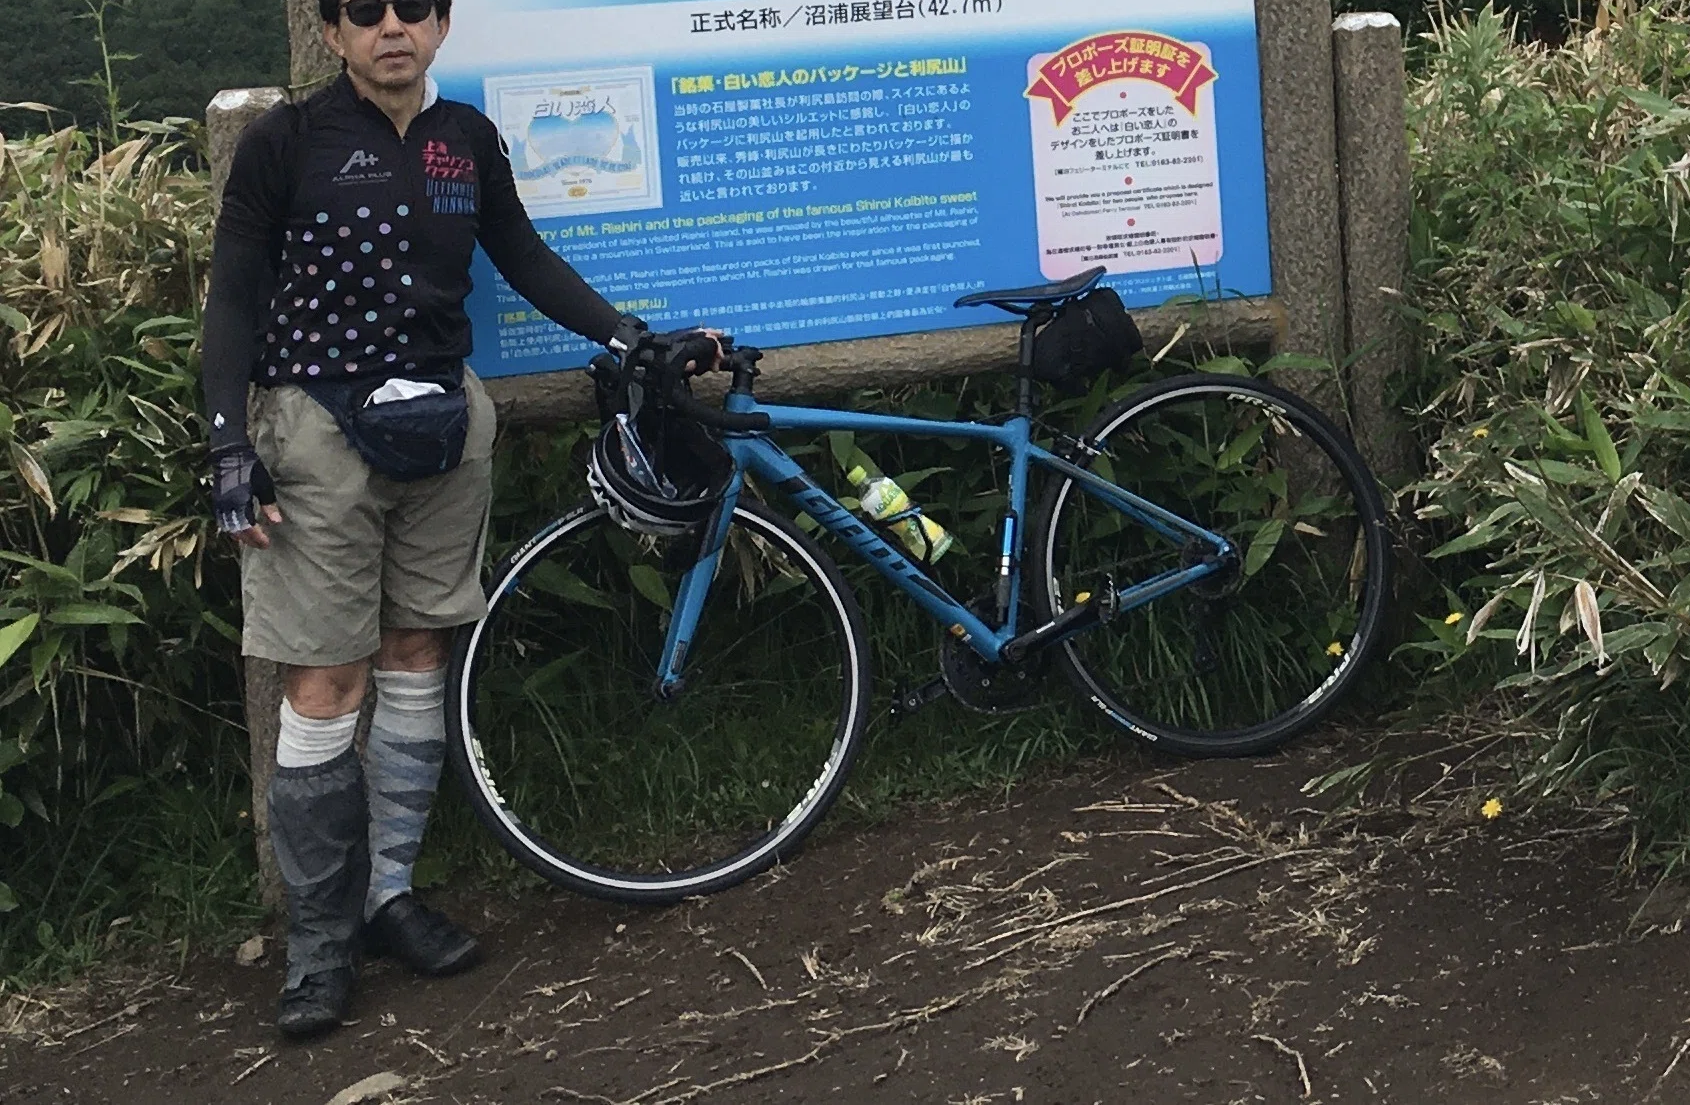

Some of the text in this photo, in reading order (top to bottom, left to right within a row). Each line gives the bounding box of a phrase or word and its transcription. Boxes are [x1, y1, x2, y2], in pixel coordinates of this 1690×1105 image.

[1073, 56, 1172, 88] 差し上げます
[1072, 105, 1175, 122] ここでプロポーズをした
[1094, 147, 1156, 162] 差し上げます。
[561, 225, 574, 239] of
[577, 224, 598, 237] Mt.
[601, 220, 643, 234] Rishiri
[645, 217, 669, 231] and
[672, 216, 694, 229] the
[696, 210, 764, 227] packaging
[767, 206, 779, 220] of
[782, 206, 803, 218] the
[805, 203, 853, 216] famous
[855, 197, 891, 212] Shiroi
[894, 193, 938, 208] Koibito
[940, 190, 977, 204] sweet
[562, 240, 606, 252] president
[608, 239, 618, 247] of
[742, 227, 753, 235] he
[811, 220, 823, 229] by
[824, 219, 839, 227] the
[841, 215, 878, 226] beautiful
[924, 210, 933, 218] of
[599, 249, 643, 259] mountain
[715, 240, 734, 248] This
[746, 236, 765, 246] said
[767, 236, 777, 244] to
[778, 234, 800, 242] have
[802, 232, 825, 241] been
[826, 230, 841, 238] the
[892, 224, 904, 232] for
[906, 223, 920, 231] the
[922, 219, 968, 230] packaging
[969, 216, 978, 225] of
[609, 283, 633, 292] been
[634, 281, 649, 290] the
[650, 277, 695, 288] viewpoint
[696, 275, 718, 283] from
[719, 272, 745, 282] which
[792, 266, 811, 275] was
[813, 263, 840, 273] drawn
[841, 261, 854, 270] for
[856, 259, 874, 268] that
[875, 257, 907, 266] famous
[660, 268, 677, 276] has
[678, 266, 700, 275] been
[702, 261, 740, 272] featured
[741, 260, 752, 268] on
[754, 258, 780, 268] packs
[782, 256, 791, 265] of
[922, 242, 941, 251] first
[510, 536, 537, 564] GIANT
[804, 494, 935, 591] GIANT
[1129, 724, 1158, 742] GIANT
